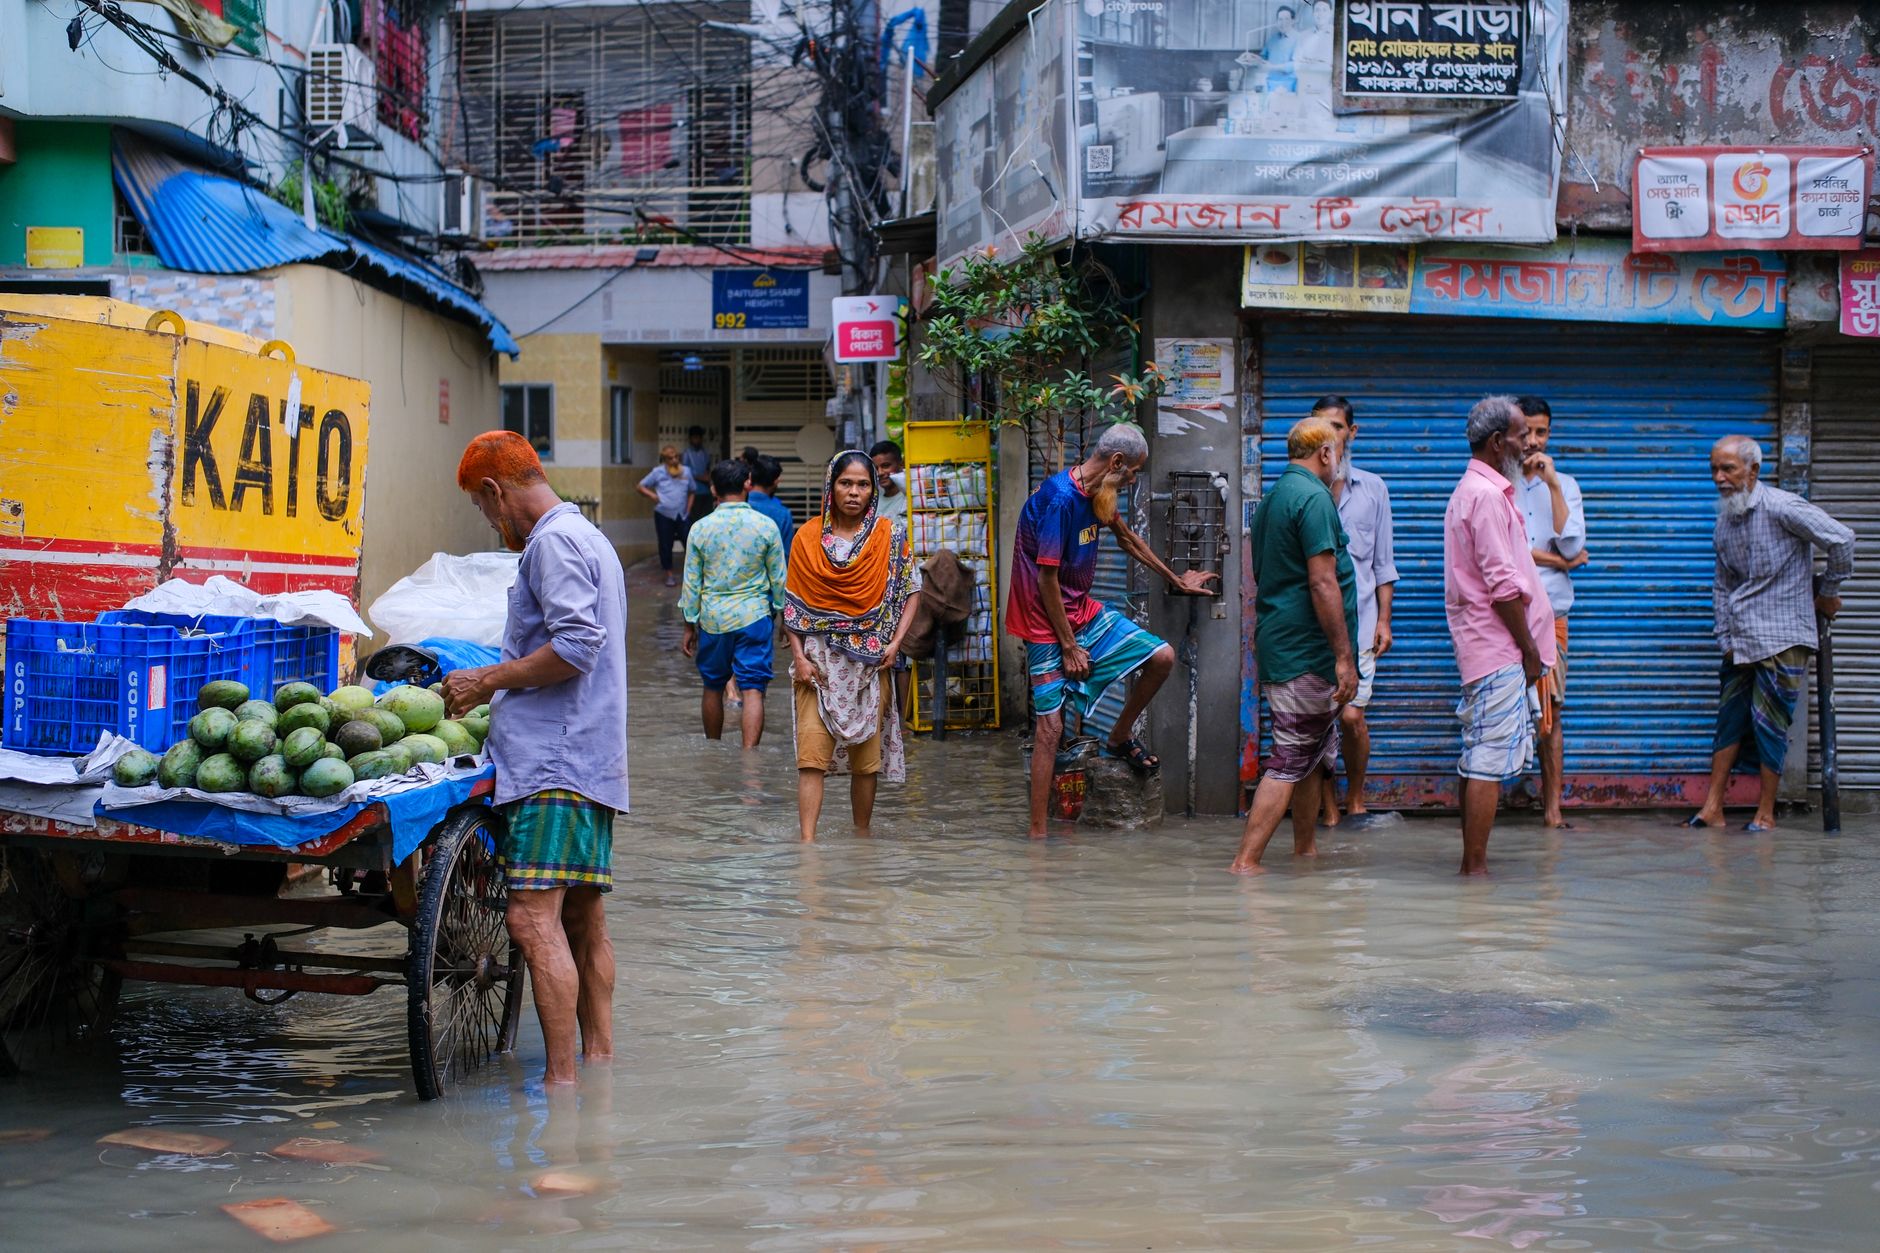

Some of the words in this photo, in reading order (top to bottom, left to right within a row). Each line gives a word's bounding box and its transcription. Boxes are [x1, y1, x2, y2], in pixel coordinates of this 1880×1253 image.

[1105, 1, 1164, 16] citygroup
[1348, 0, 1424, 36] খান
[1429, 0, 1522, 41] বাড়ী
[1347, 38, 1378, 58] মোঃ
[1453, 43, 1480, 60] হক
[1484, 42, 1516, 61] খান
[1403, 59, 1428, 79] পূর্ব
[1320, 163, 1379, 181] গভীরতা
[1673, 183, 1700, 199] মানি
[1800, 191, 1828, 203] ক্যাশ
[1829, 189, 1861, 204] আউট
[1115, 201, 1290, 231] রমজান
[1310, 196, 1360, 231] টি
[1724, 203, 1781, 225] নগদ
[1817, 203, 1843, 217] চার্জ
[1422, 256, 1612, 308] রমজান
[1621, 251, 1681, 308] টি
[768, 287, 802, 297] SHARIF
[744, 299, 785, 308] HEIGHTS
[715, 312, 747, 329] 992
[851, 327, 882, 340] বিকাশ
[850, 339, 884, 352] পেমেন্ট
[182, 379, 352, 522] KATO
[13, 662, 25, 731] GOPI
[127, 671, 138, 741] GOPI
